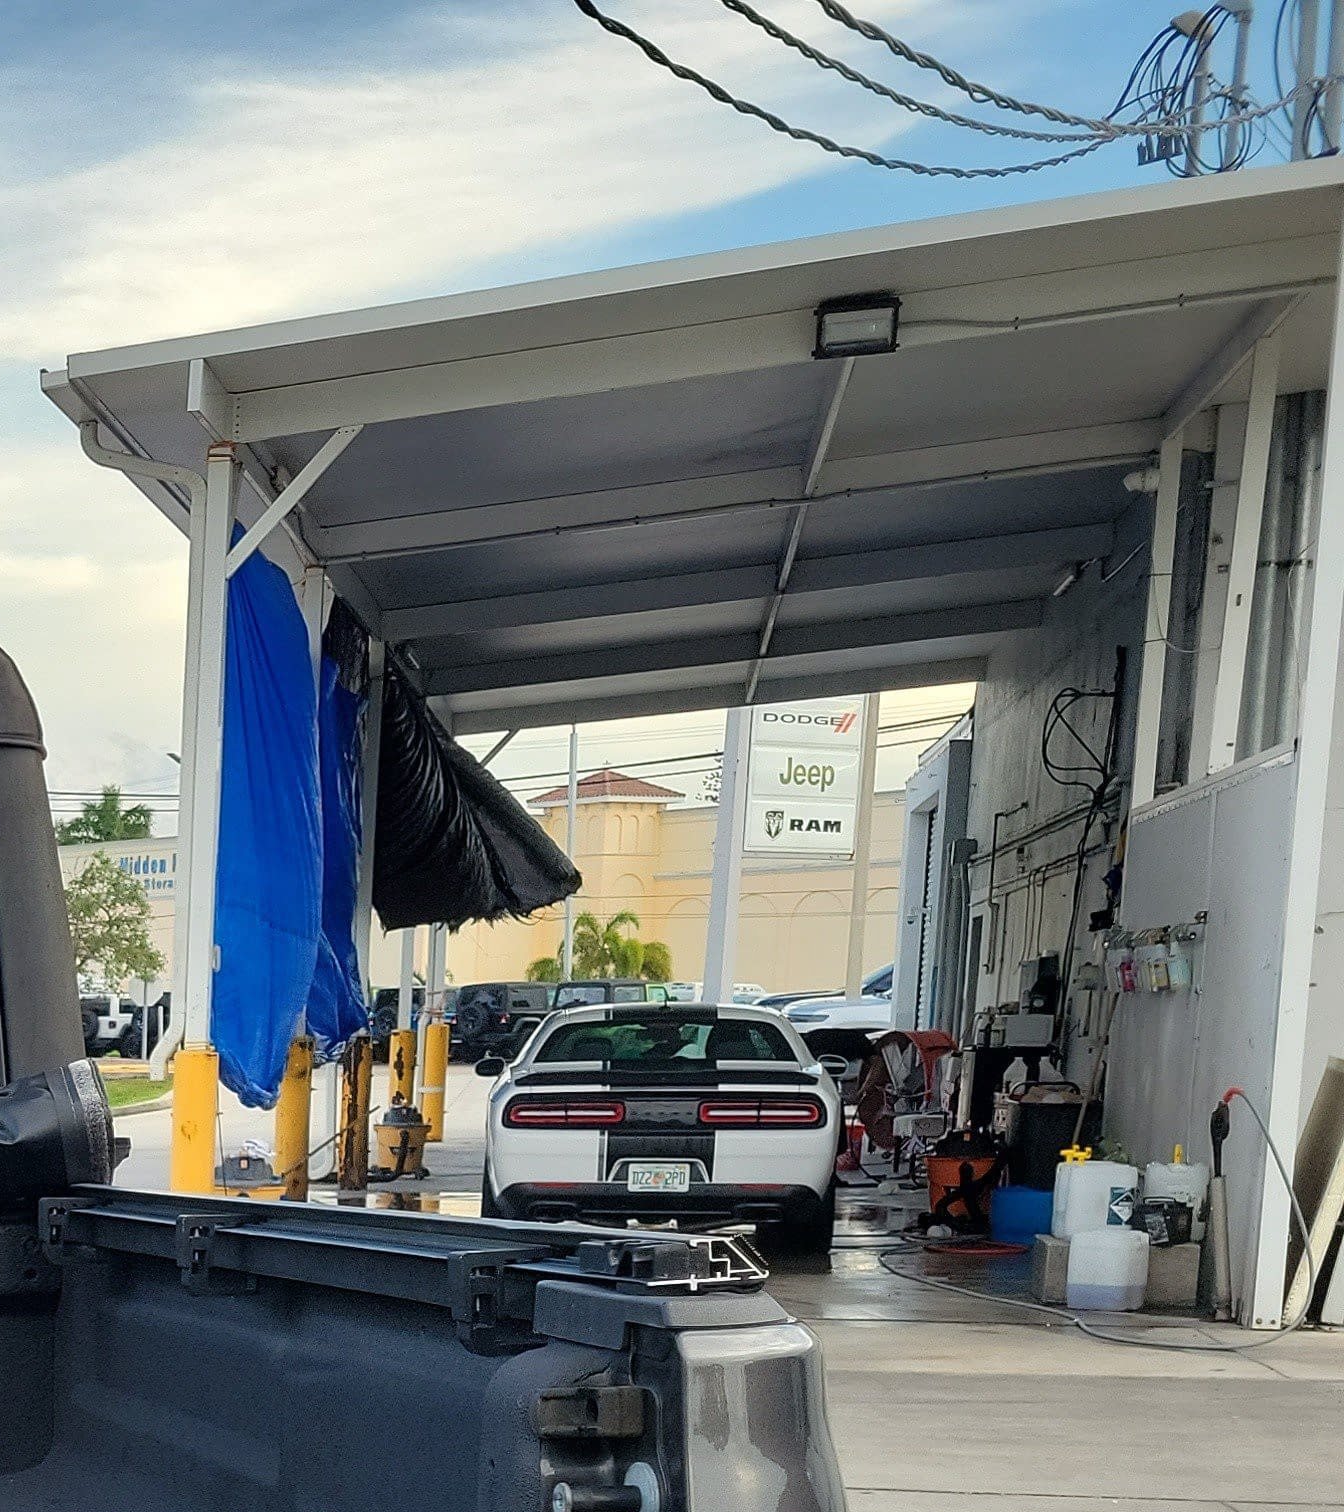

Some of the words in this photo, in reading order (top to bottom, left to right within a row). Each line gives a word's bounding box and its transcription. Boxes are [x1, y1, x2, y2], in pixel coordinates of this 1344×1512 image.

[763, 713, 843, 726] DODGE
[779, 757, 835, 792] Jeep
[789, 818, 842, 833] RAM
